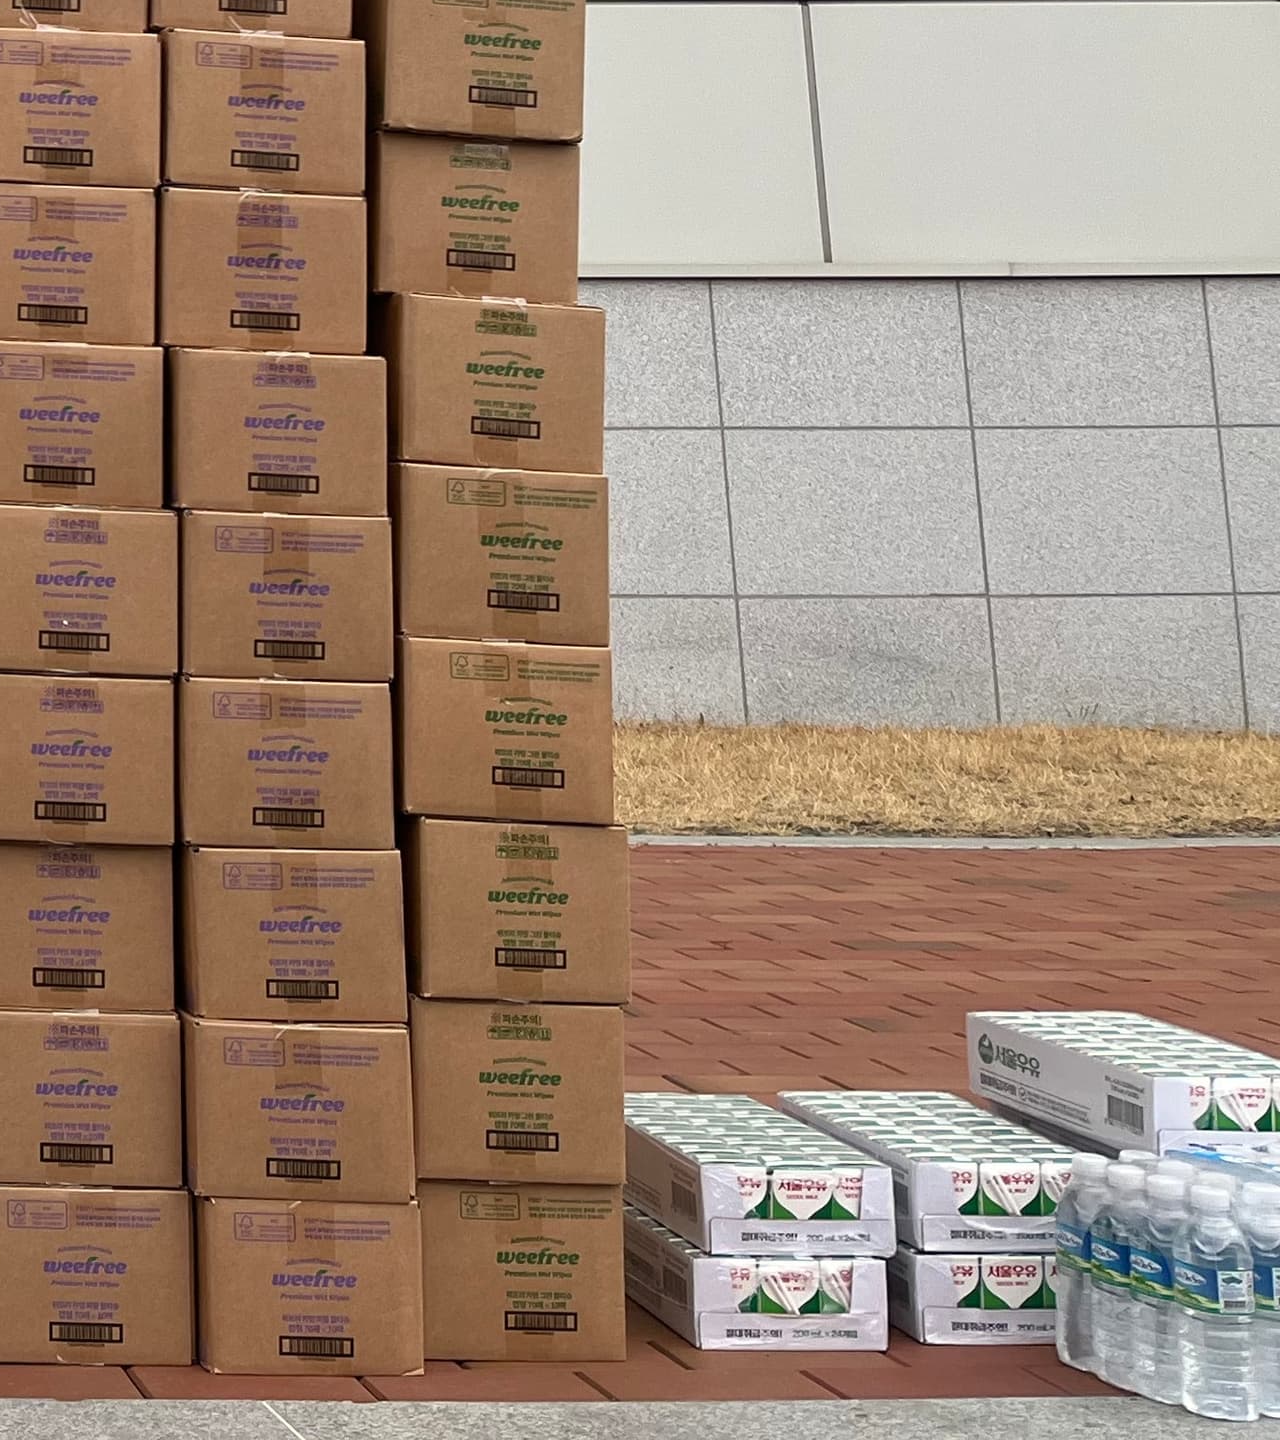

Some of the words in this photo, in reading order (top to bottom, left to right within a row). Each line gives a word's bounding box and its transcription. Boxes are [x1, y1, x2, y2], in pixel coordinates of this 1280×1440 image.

[464, 33, 541, 48] weefree
[19, 89, 98, 106] weefree
[228, 93, 305, 110] weefree
[441, 194, 520, 211] weefree
[13, 246, 93, 263] weefree
[227, 253, 306, 270] weefree
[466, 361, 544, 378] weefree
[19, 405, 100, 423] weefree
[244, 413, 325, 431] weefree
[480, 532, 563, 551] weefree
[36, 570, 116, 588] weefree
[249, 579, 330, 597] weefree
[485, 707, 567, 726] weefree
[31, 740, 112, 758] weefree
[248, 745, 329, 764] weefree
[488, 887, 568, 905] weefree
[28, 905, 110, 924] weefree
[259, 915, 342, 934] weefree
[994, 1046, 1040, 1078] 서울우유
[479, 1068, 561, 1087] weefree
[36, 1079, 118, 1098] weefree
[260, 1094, 344, 1113] weefree
[496, 1247, 579, 1266] weefree
[44, 1257, 127, 1276] weefree
[987, 1265, 1037, 1278] 서울우유
[272, 1270, 357, 1289] weefree
